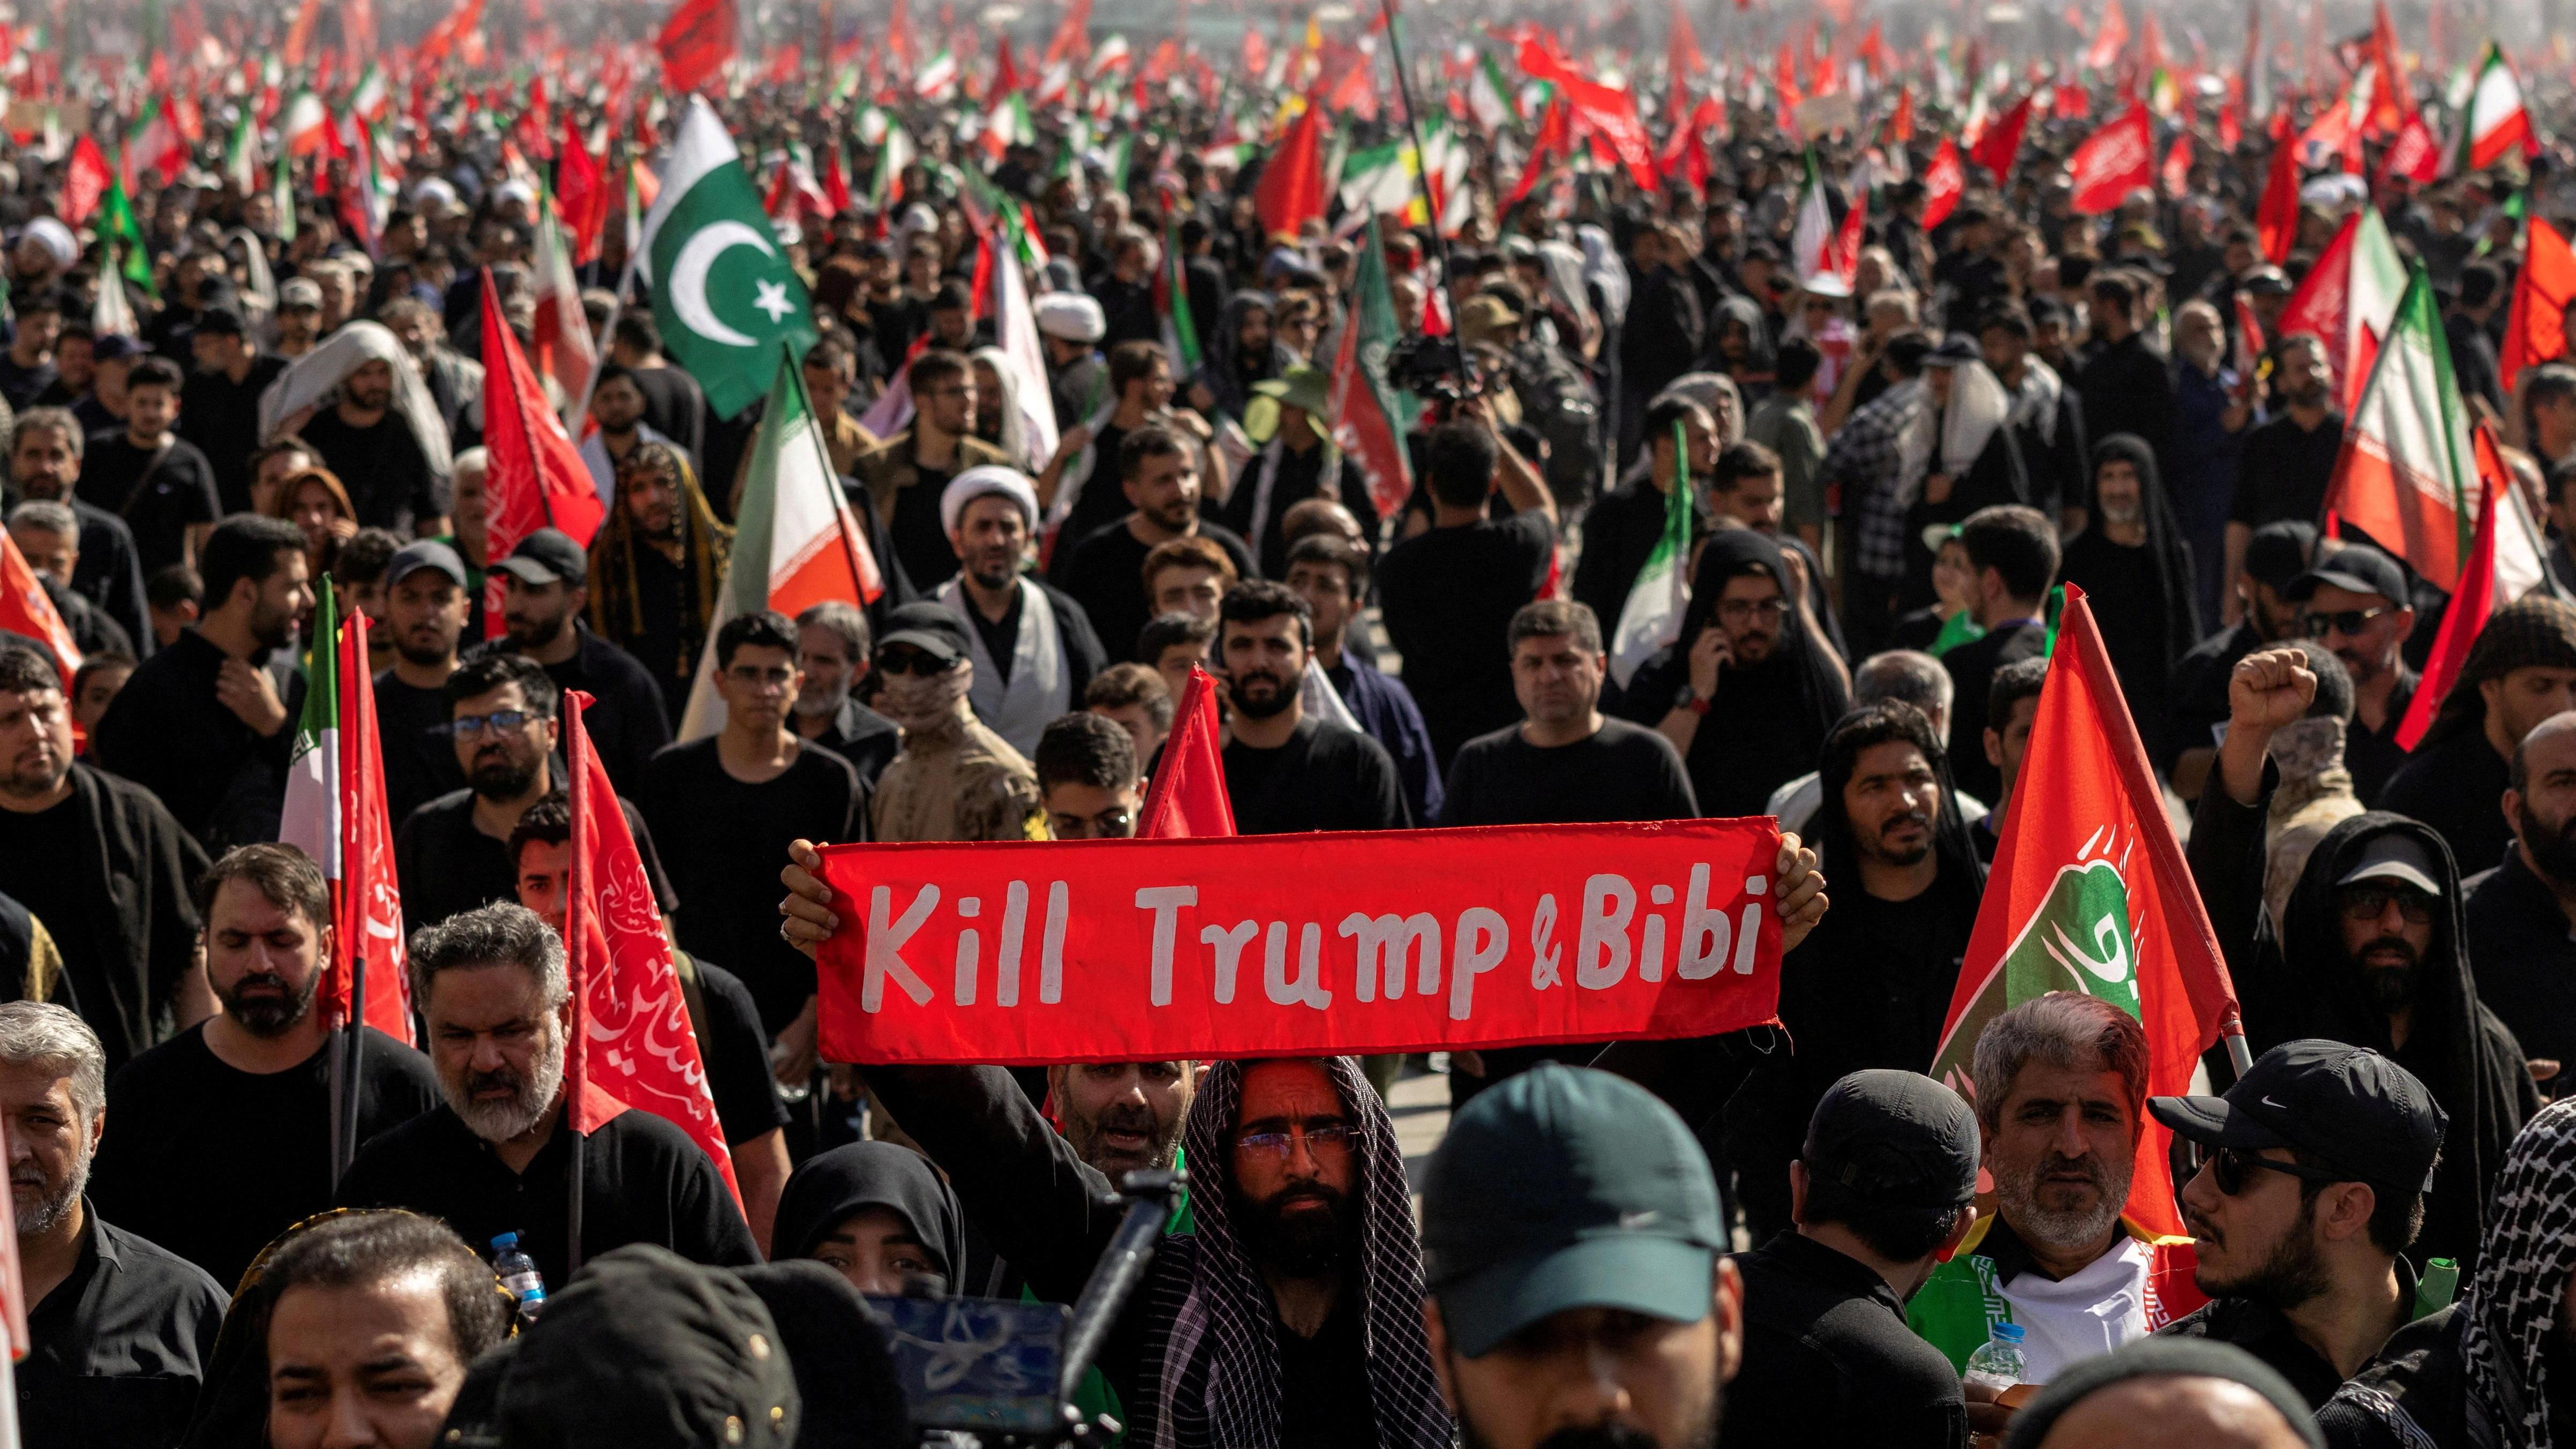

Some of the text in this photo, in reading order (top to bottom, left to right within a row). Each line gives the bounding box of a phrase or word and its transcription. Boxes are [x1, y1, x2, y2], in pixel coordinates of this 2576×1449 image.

[861, 862, 1768, 1022] Kill Trump & Bibi
